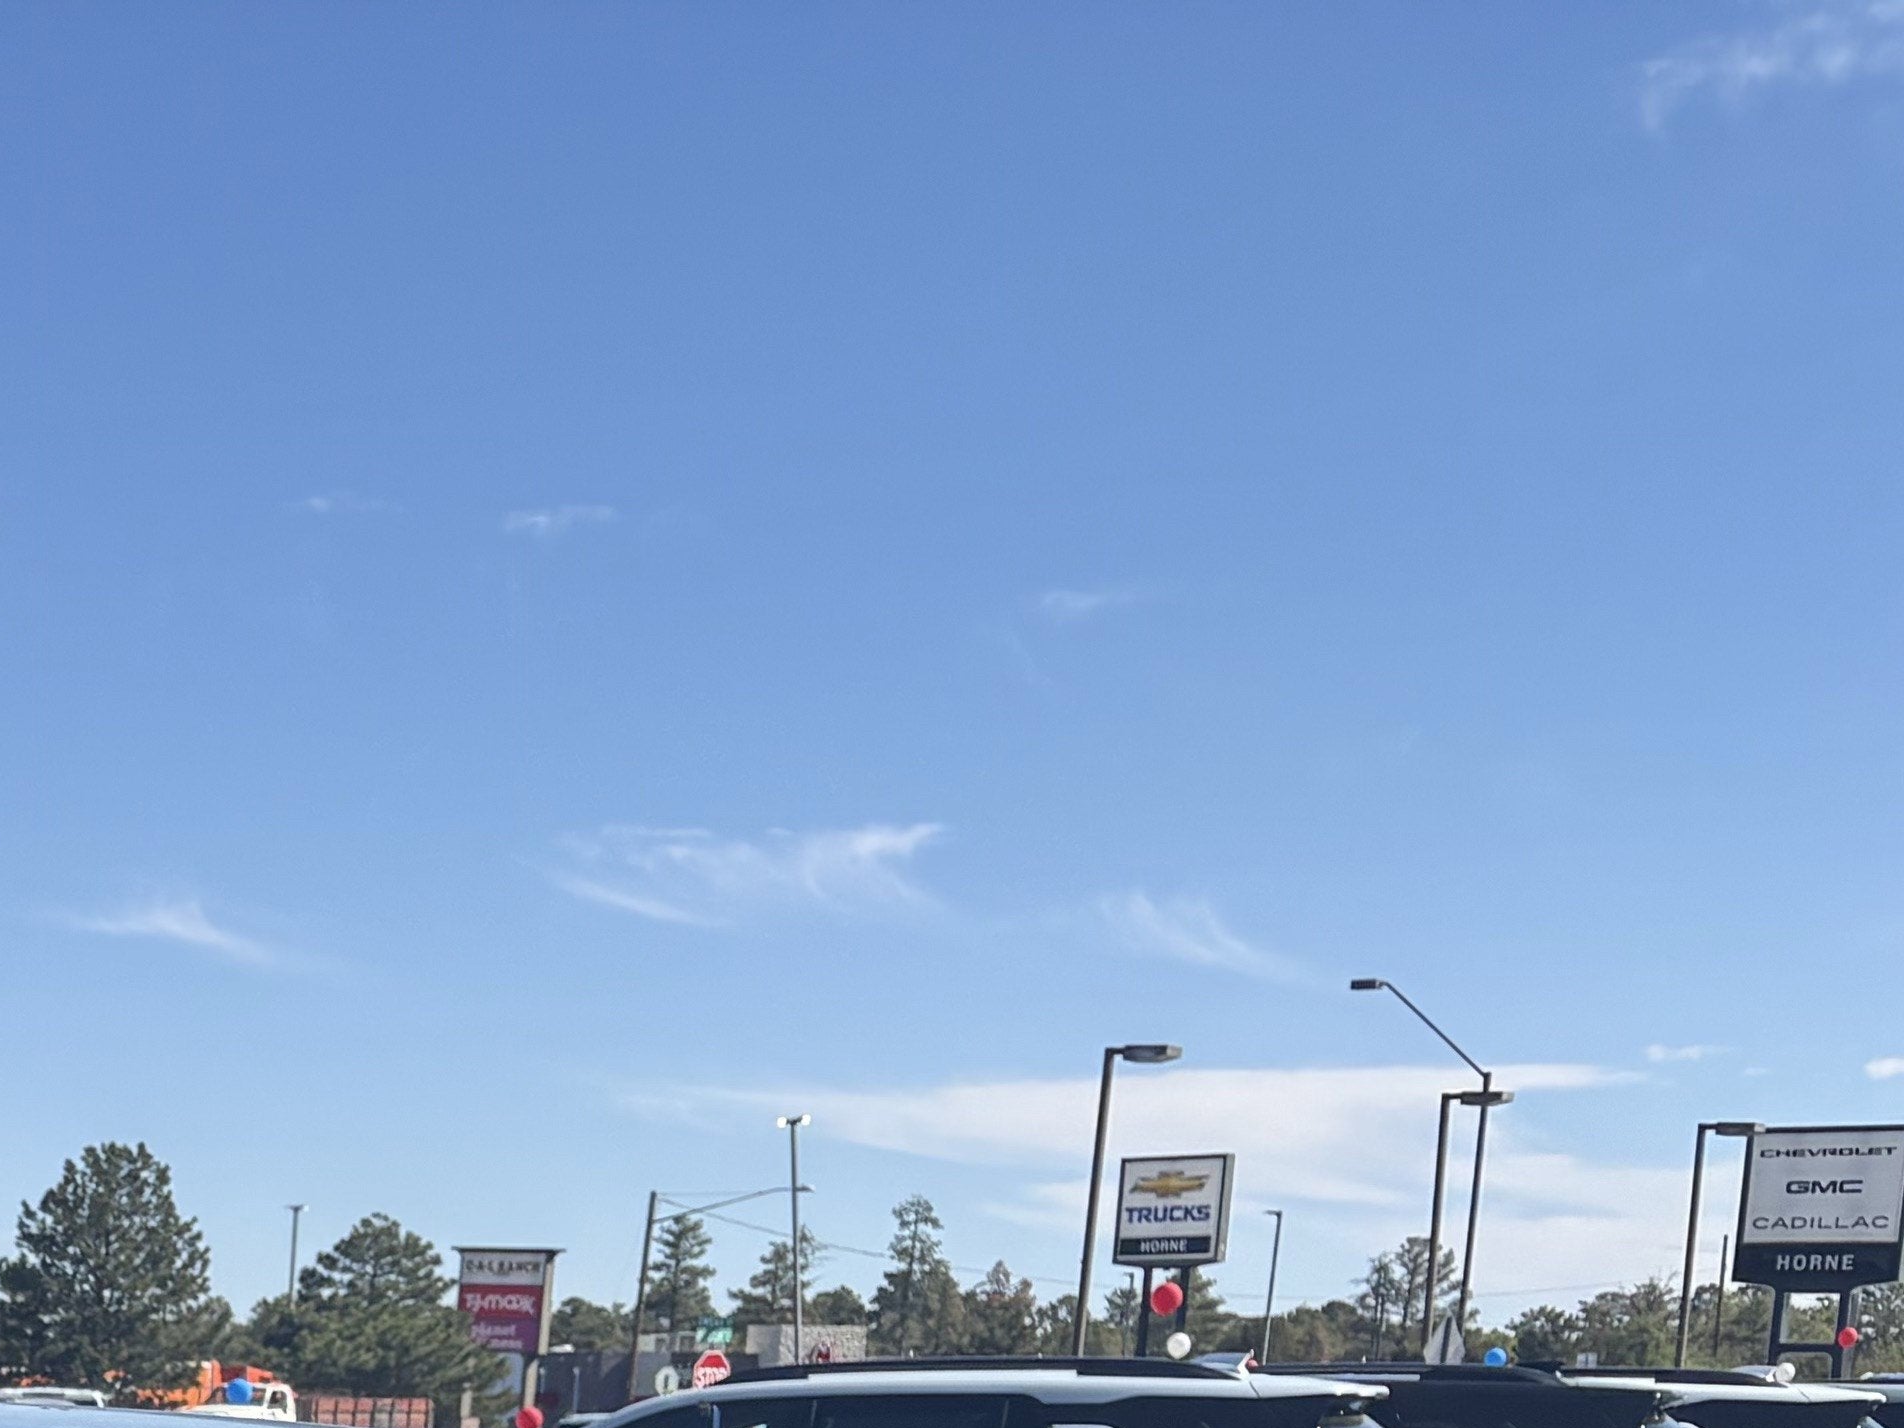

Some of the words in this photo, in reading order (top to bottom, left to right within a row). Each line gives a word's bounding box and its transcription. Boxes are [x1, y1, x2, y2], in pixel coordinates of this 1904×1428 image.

[1760, 1146, 1897, 1158] CHEVROLET
[1785, 1179, 1864, 1194] GMC
[1125, 1204, 1211, 1223] TRUCKS
[1752, 1215, 1890, 1230] CADILLAC
[1776, 1254, 1855, 1271] HORNE
